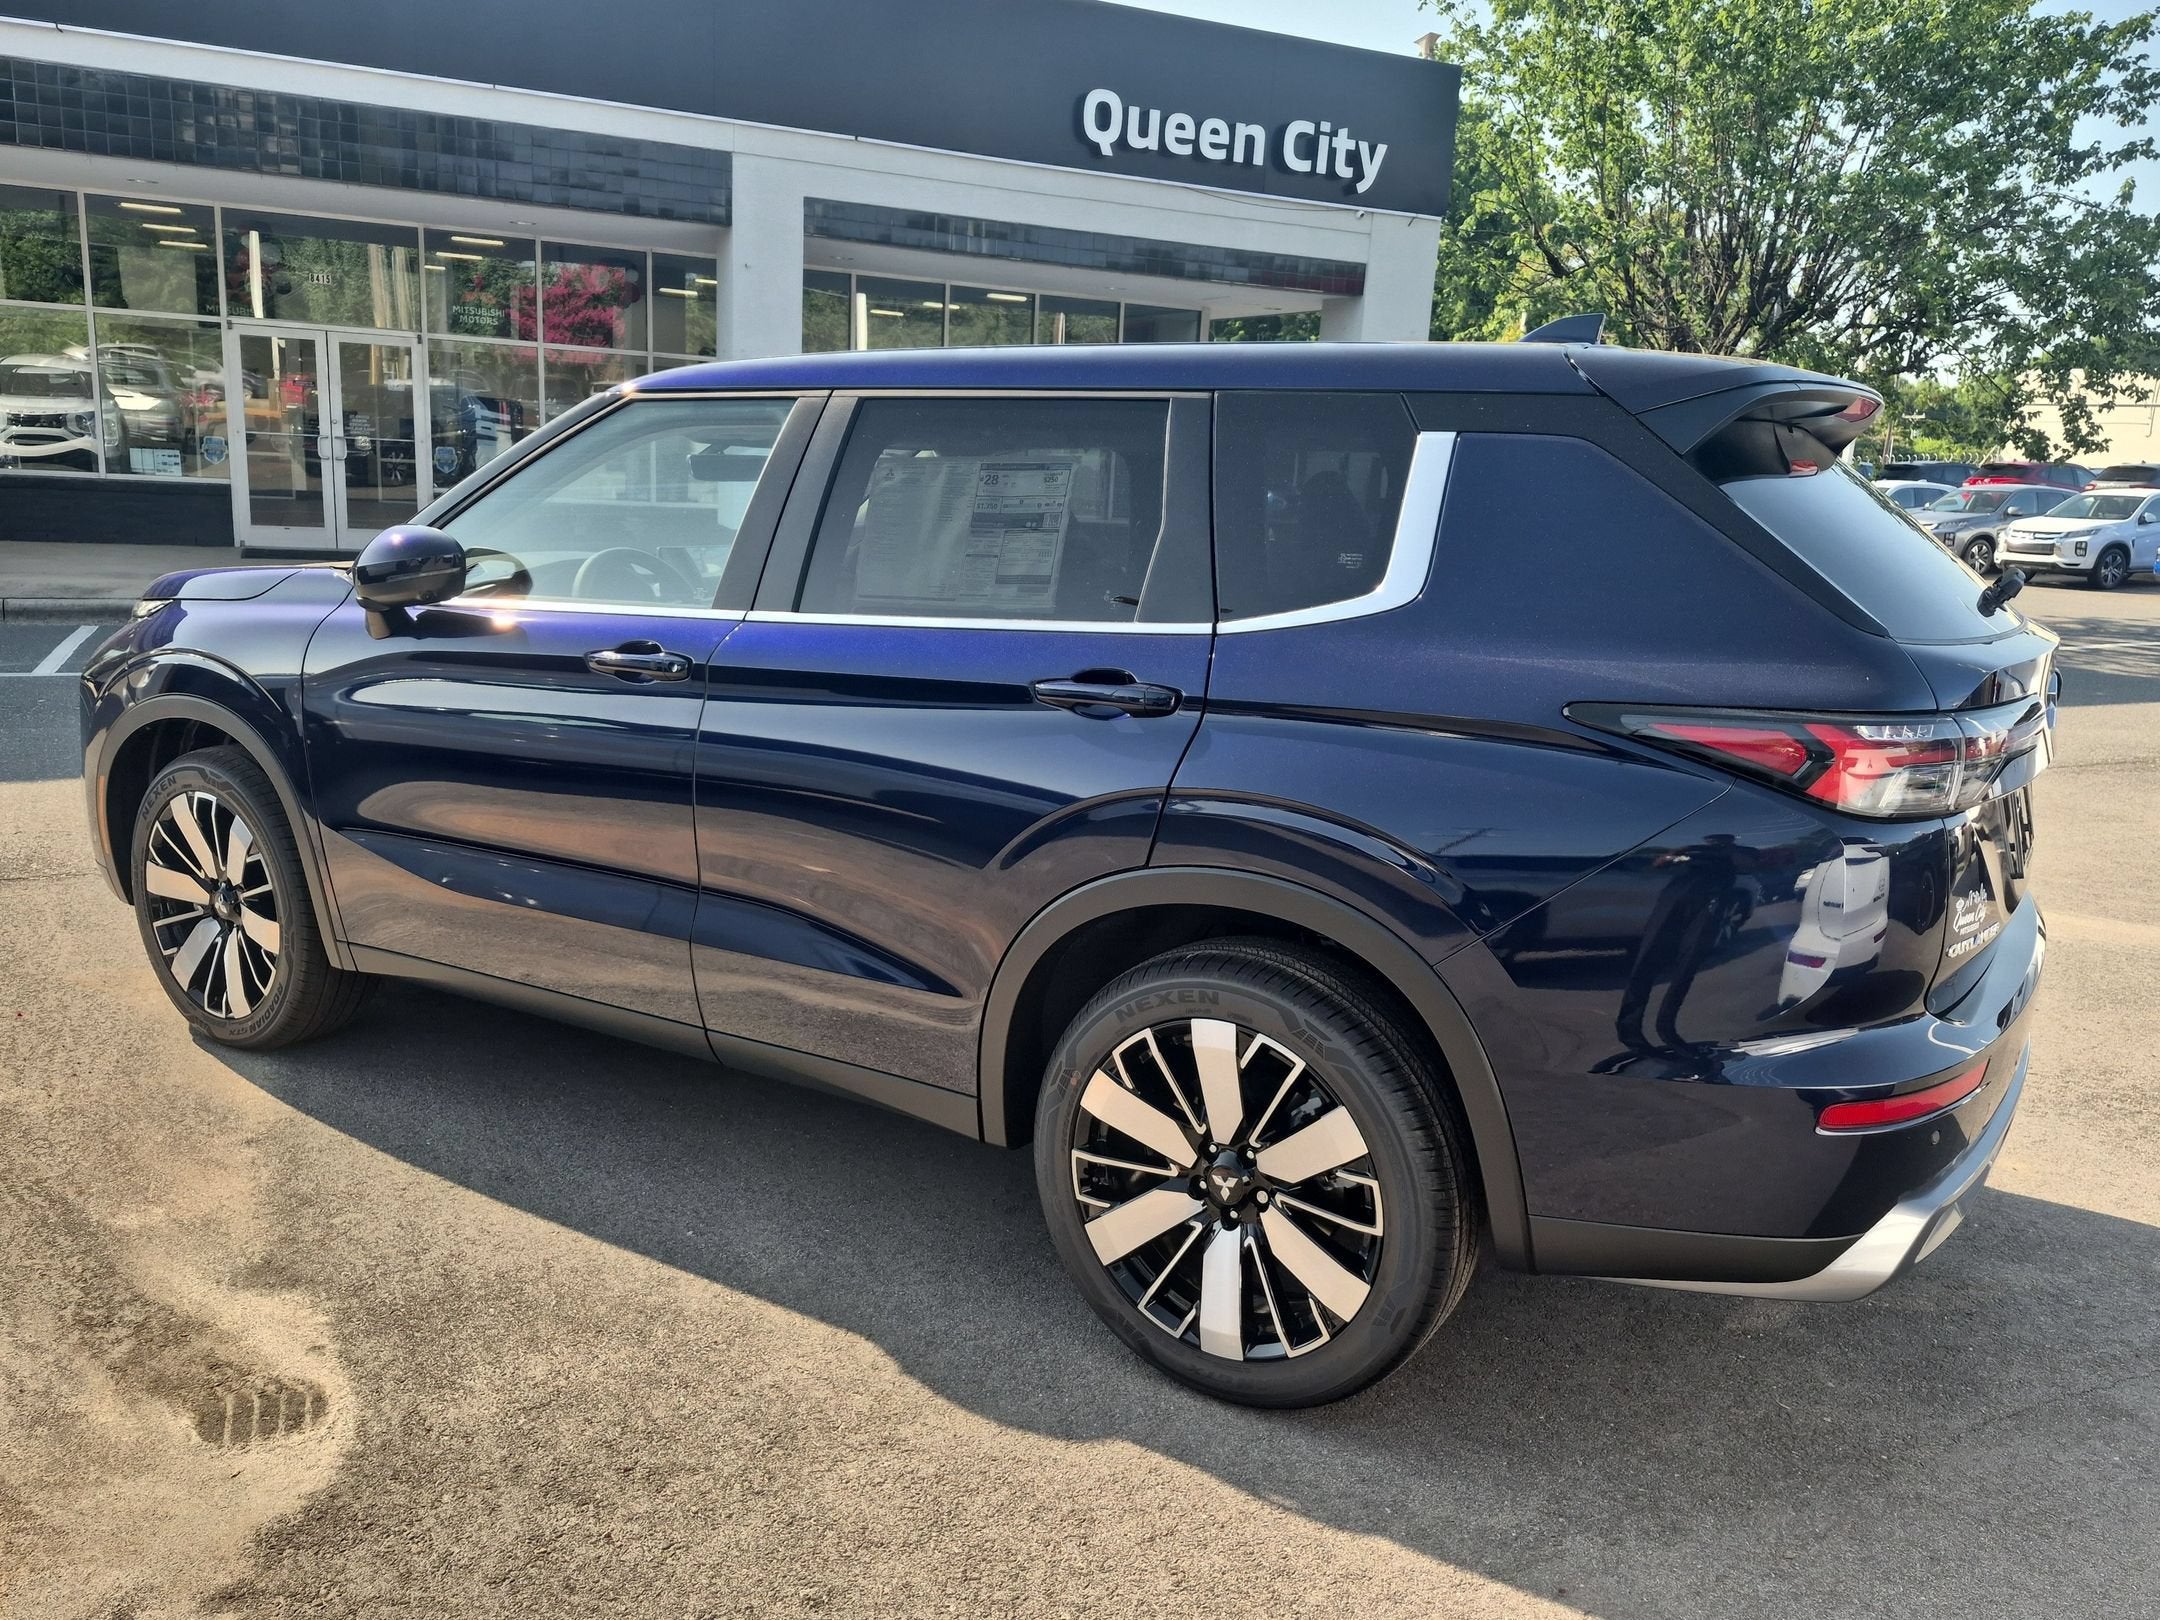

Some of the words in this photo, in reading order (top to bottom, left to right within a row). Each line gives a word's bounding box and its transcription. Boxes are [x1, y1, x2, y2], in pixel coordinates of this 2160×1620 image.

[1083, 88, 1266, 167] Queen
[1283, 120, 1389, 194] City
[309, 273, 331, 284] 8415
[452, 305, 505, 317] MITSUBISHI
[460, 315, 498, 326] MOTORS
[984, 474, 999, 486] 28
[141, 776, 177, 820] NEXEN
[249, 981, 283, 1034] ROADIAN
[1113, 989, 1220, 1021] NEXEN
